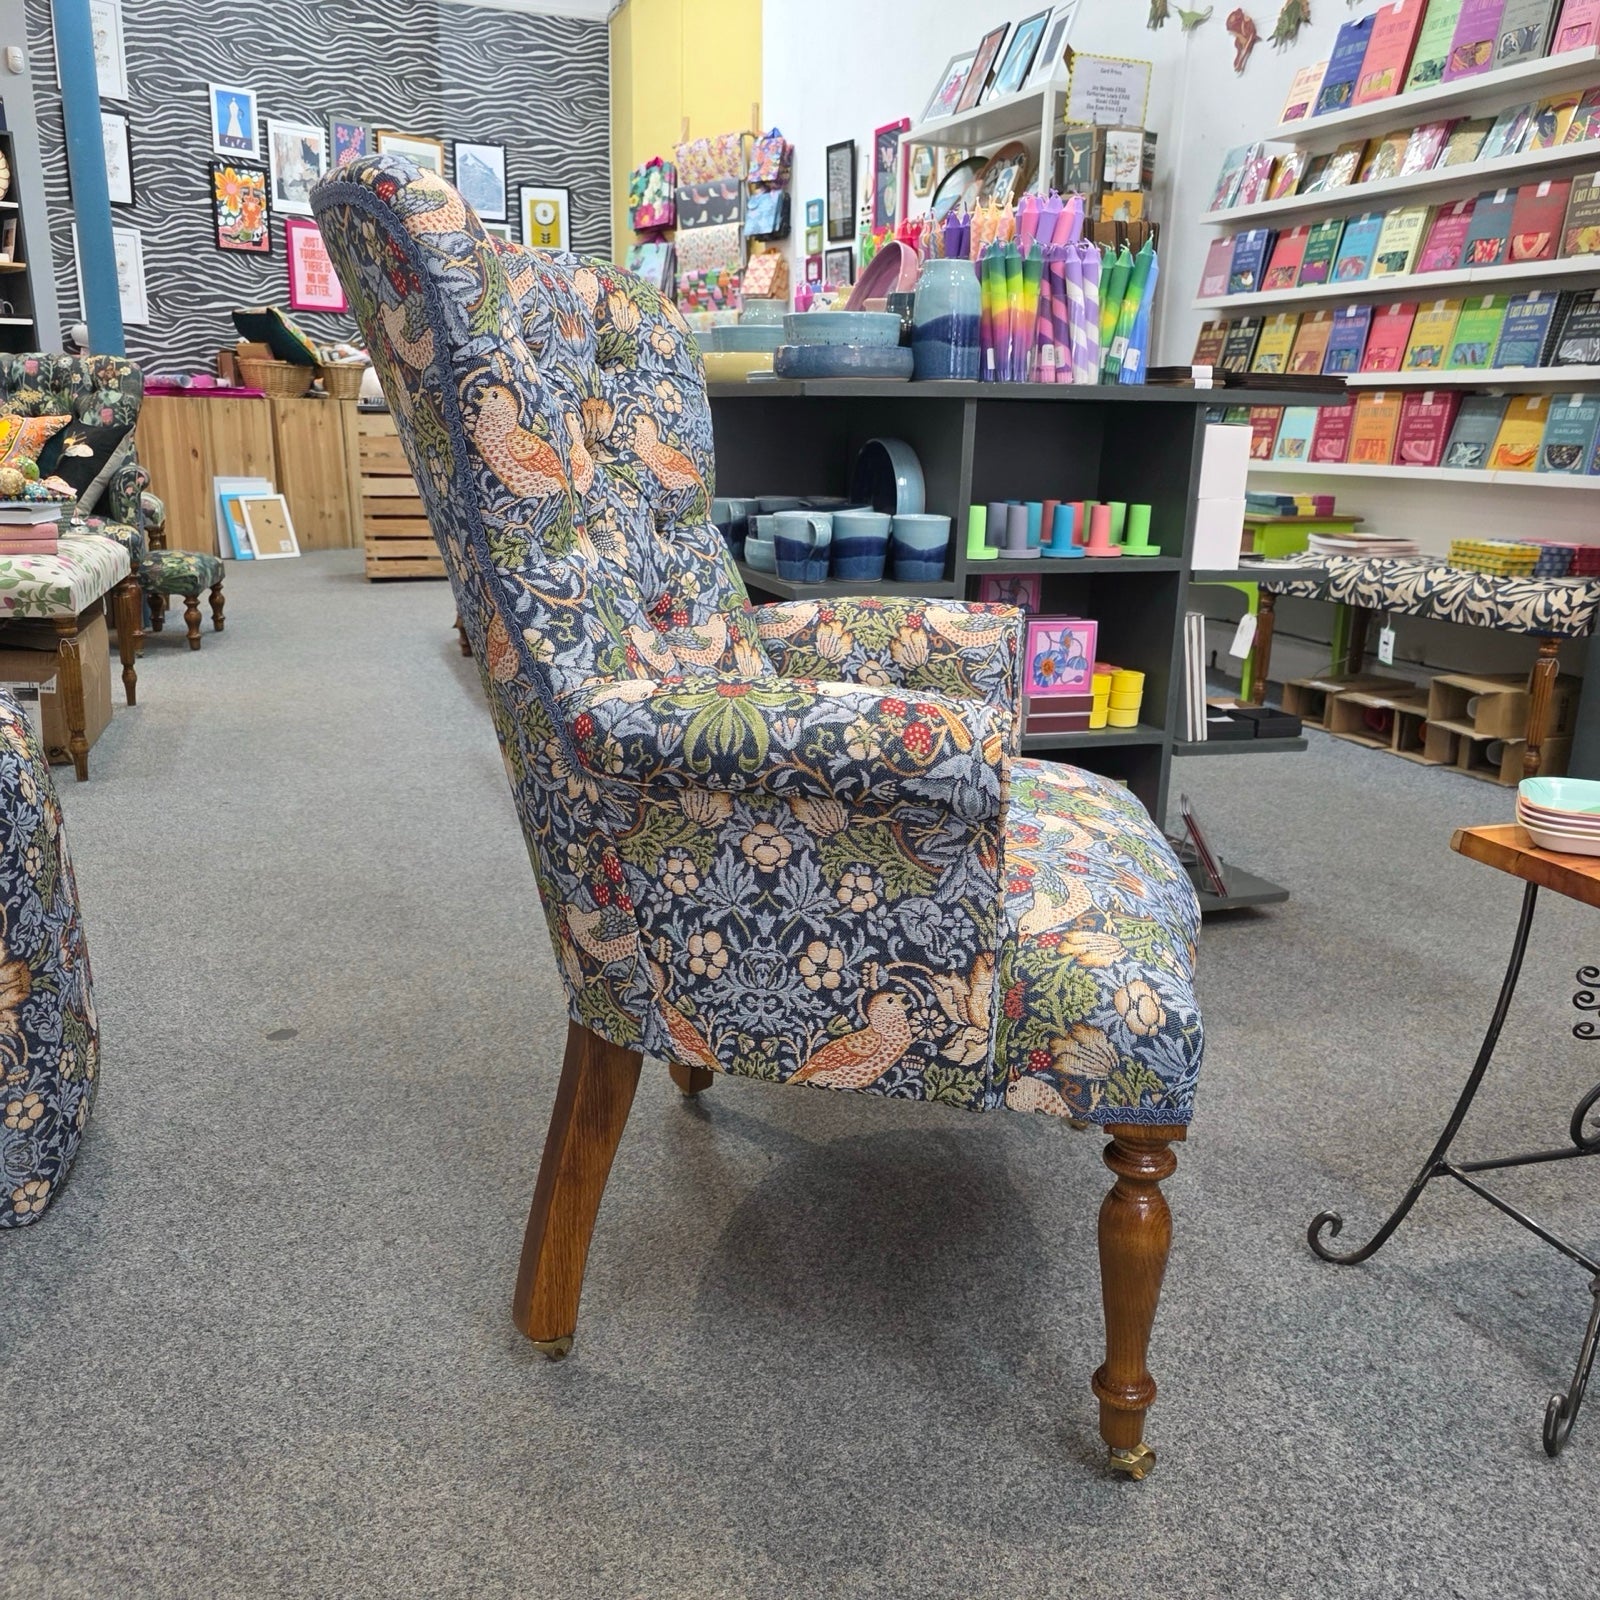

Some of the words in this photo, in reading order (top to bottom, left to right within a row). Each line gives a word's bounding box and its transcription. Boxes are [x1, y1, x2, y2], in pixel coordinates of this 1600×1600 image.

[303, 236, 320, 248] JUST
[299, 248, 330, 260] YOURSEL
[303, 260, 323, 273] THERE
[325, 262, 331, 273] IS
[306, 273, 316, 284] NO
[317, 273, 329, 285] ONE
[1509, 305, 1522, 318] EAST
[1521, 304, 1533, 317] END
[1531, 303, 1550, 316] PRESS
[1510, 324, 1539, 332] GARLAND
